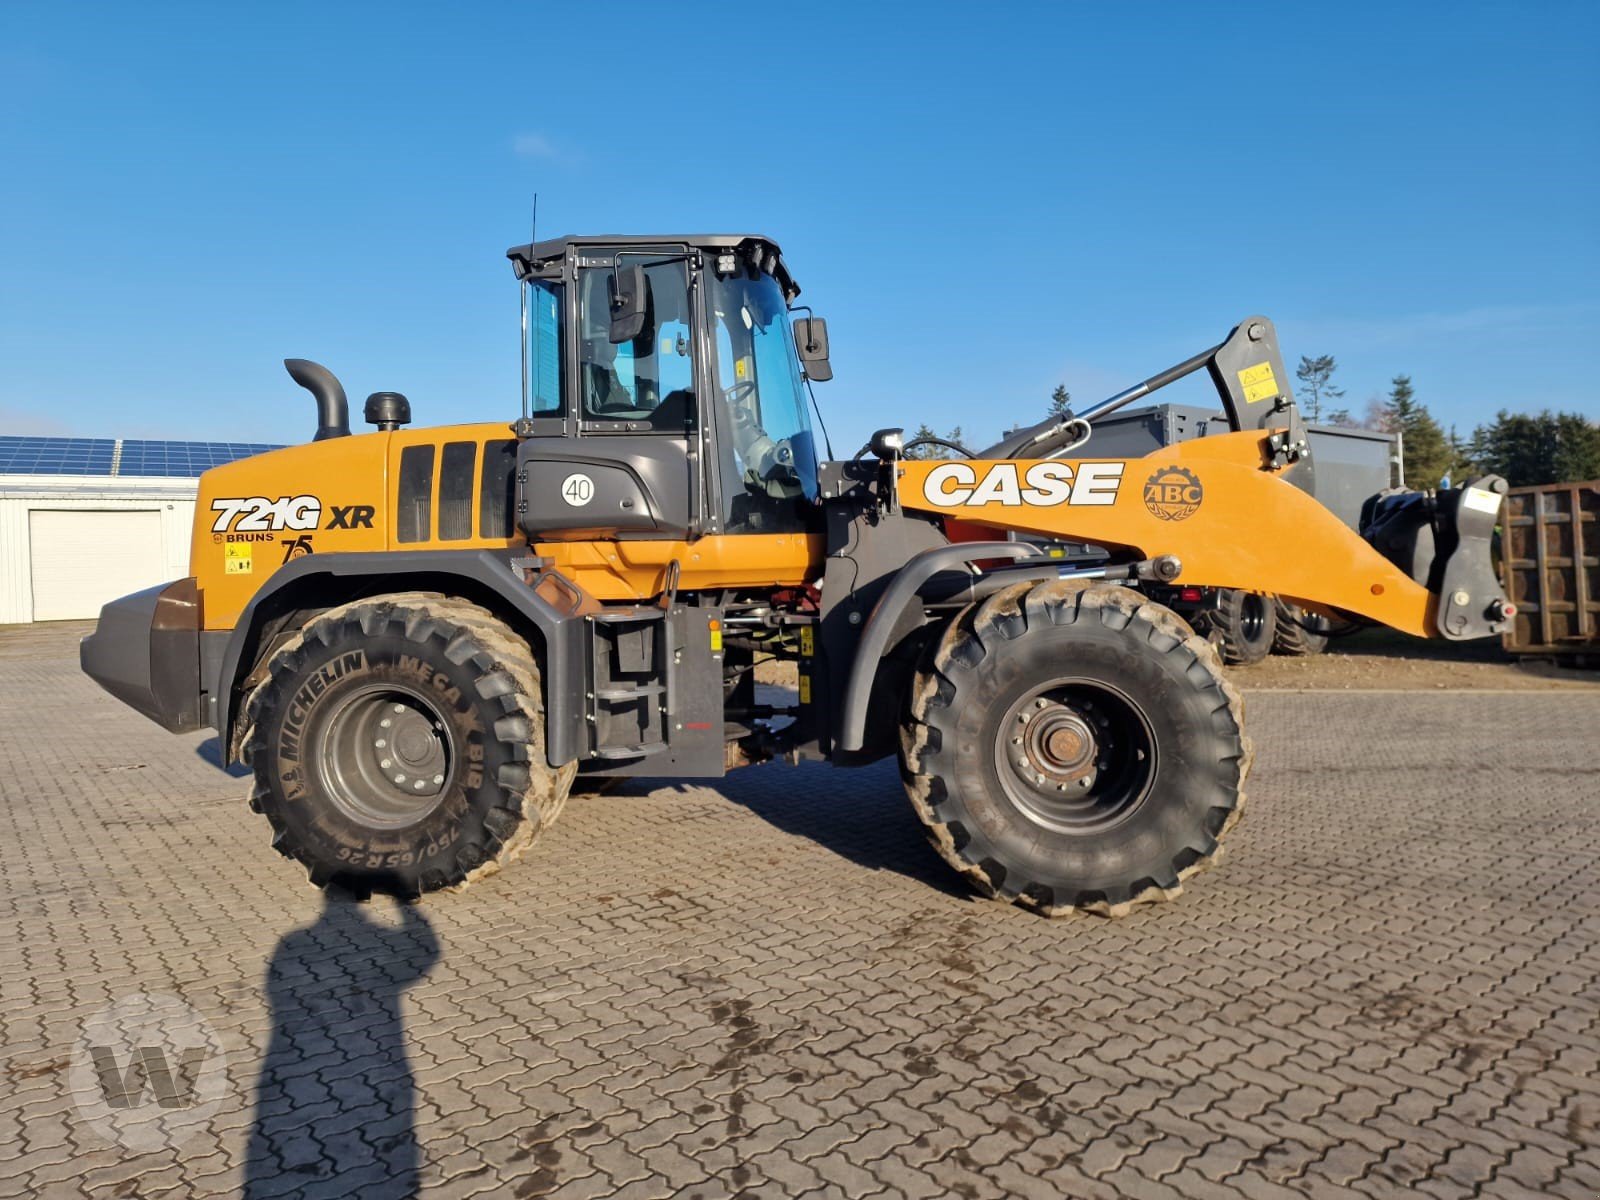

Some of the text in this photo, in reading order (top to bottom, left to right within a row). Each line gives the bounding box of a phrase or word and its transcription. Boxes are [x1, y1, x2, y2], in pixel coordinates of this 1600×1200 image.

[566, 480, 590, 501] 40
[923, 462, 1126, 507] CASE
[1145, 484, 1202, 504] ABC
[211, 495, 375, 532] 721G XR
[226, 533, 274, 543] BRUNS
[281, 535, 314, 565] 75
[279, 650, 363, 762] MICHELIN
